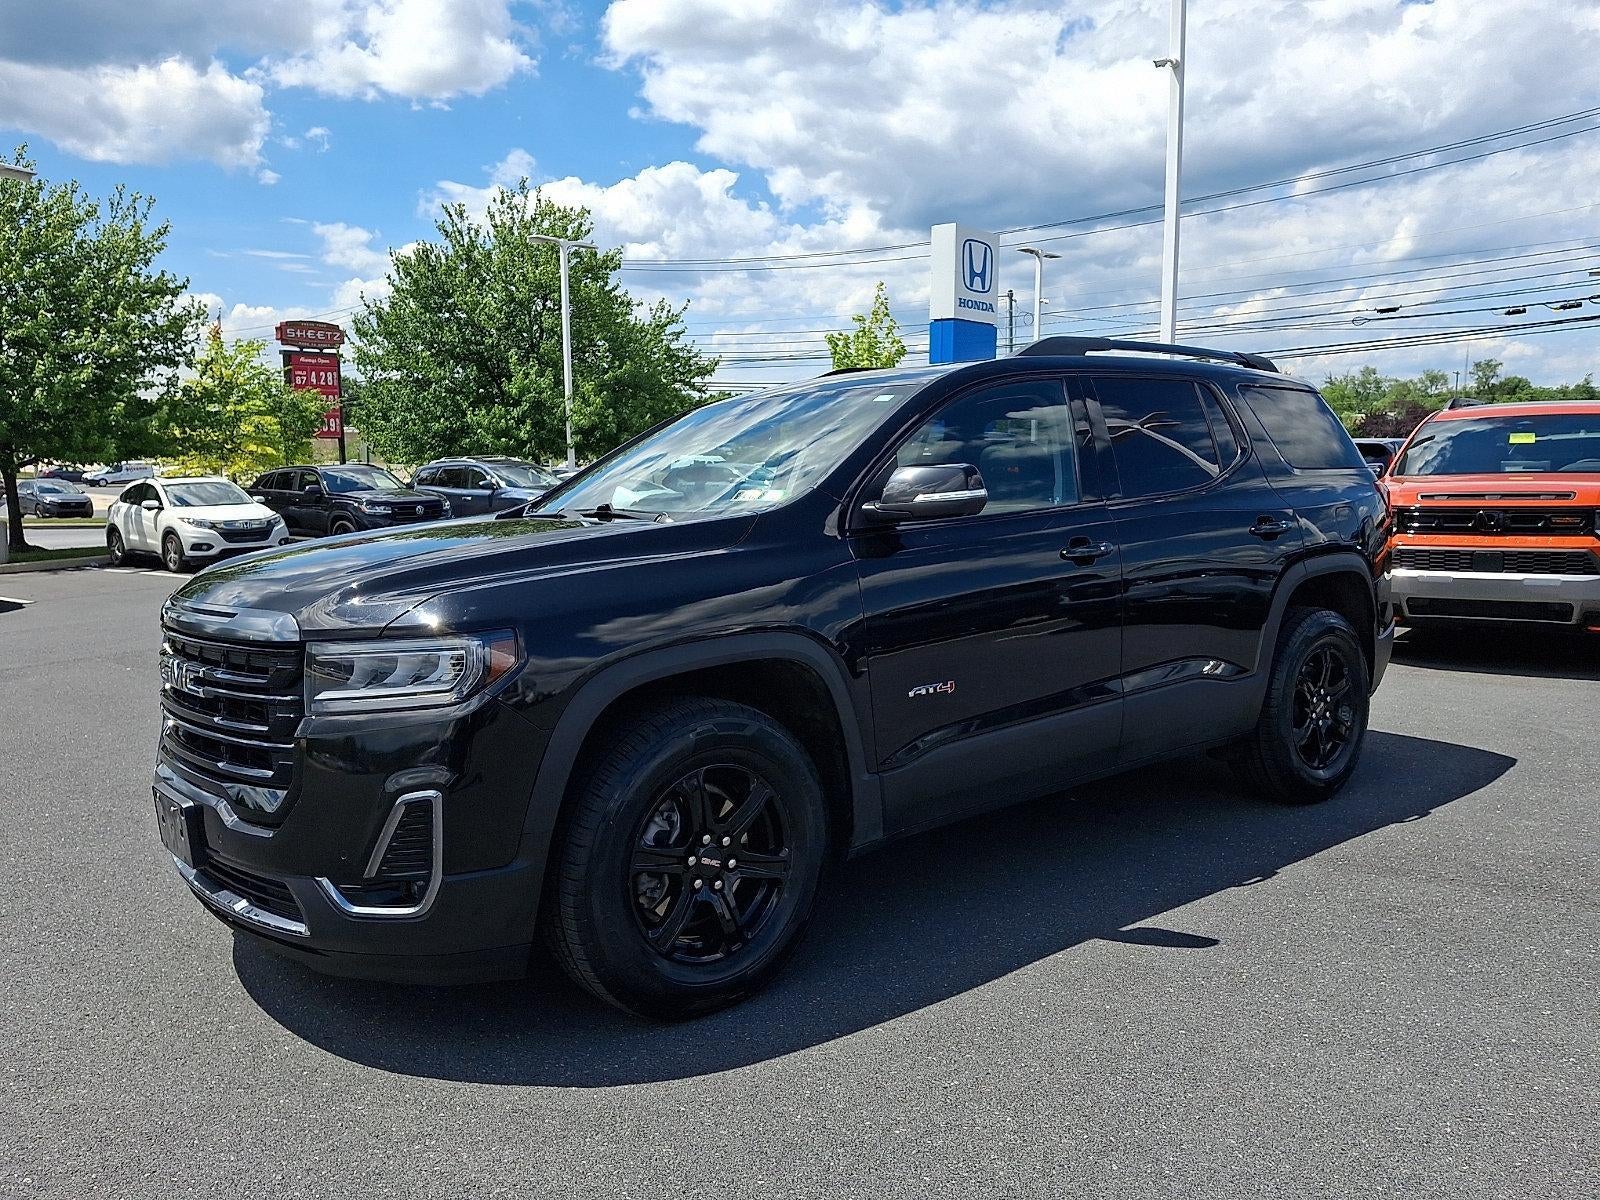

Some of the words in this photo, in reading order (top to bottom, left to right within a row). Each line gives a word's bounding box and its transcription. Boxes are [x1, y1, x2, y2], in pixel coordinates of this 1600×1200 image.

[958, 298, 995, 313] HONDA
[286, 329, 340, 340] SHEETZ
[295, 376, 307, 385] 87
[908, 680, 955, 698] AT4
[701, 857, 721, 867] GMC
